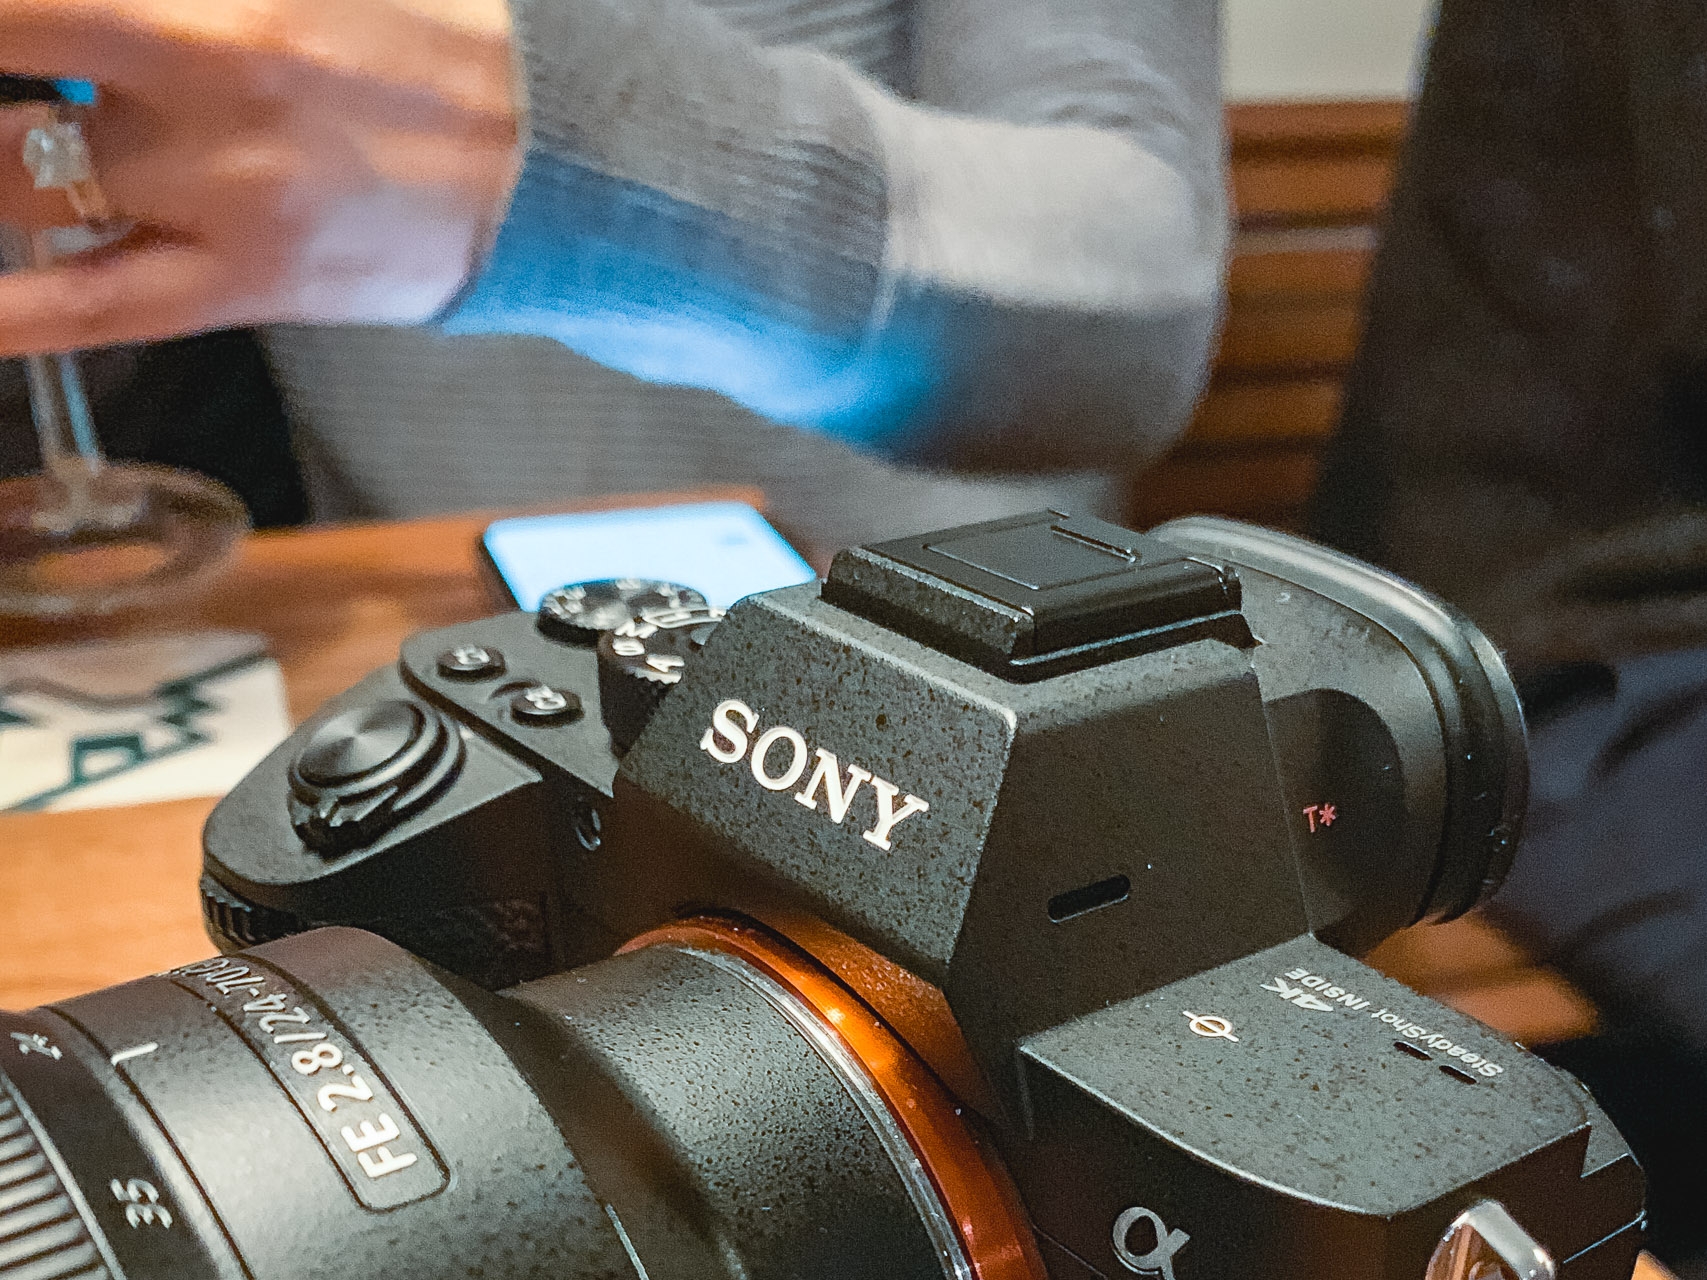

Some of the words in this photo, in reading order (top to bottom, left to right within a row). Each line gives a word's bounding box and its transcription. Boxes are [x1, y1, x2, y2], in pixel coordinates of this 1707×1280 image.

[700, 699, 930, 851] SONY
[1260, 976, 1334, 1012] 4K
[1284, 967, 1371, 1011] INSIDE
[1369, 1007, 1505, 1078] SteadyShot
[341, 1112, 417, 1178] FE
[110, 1178, 173, 1229] 35
